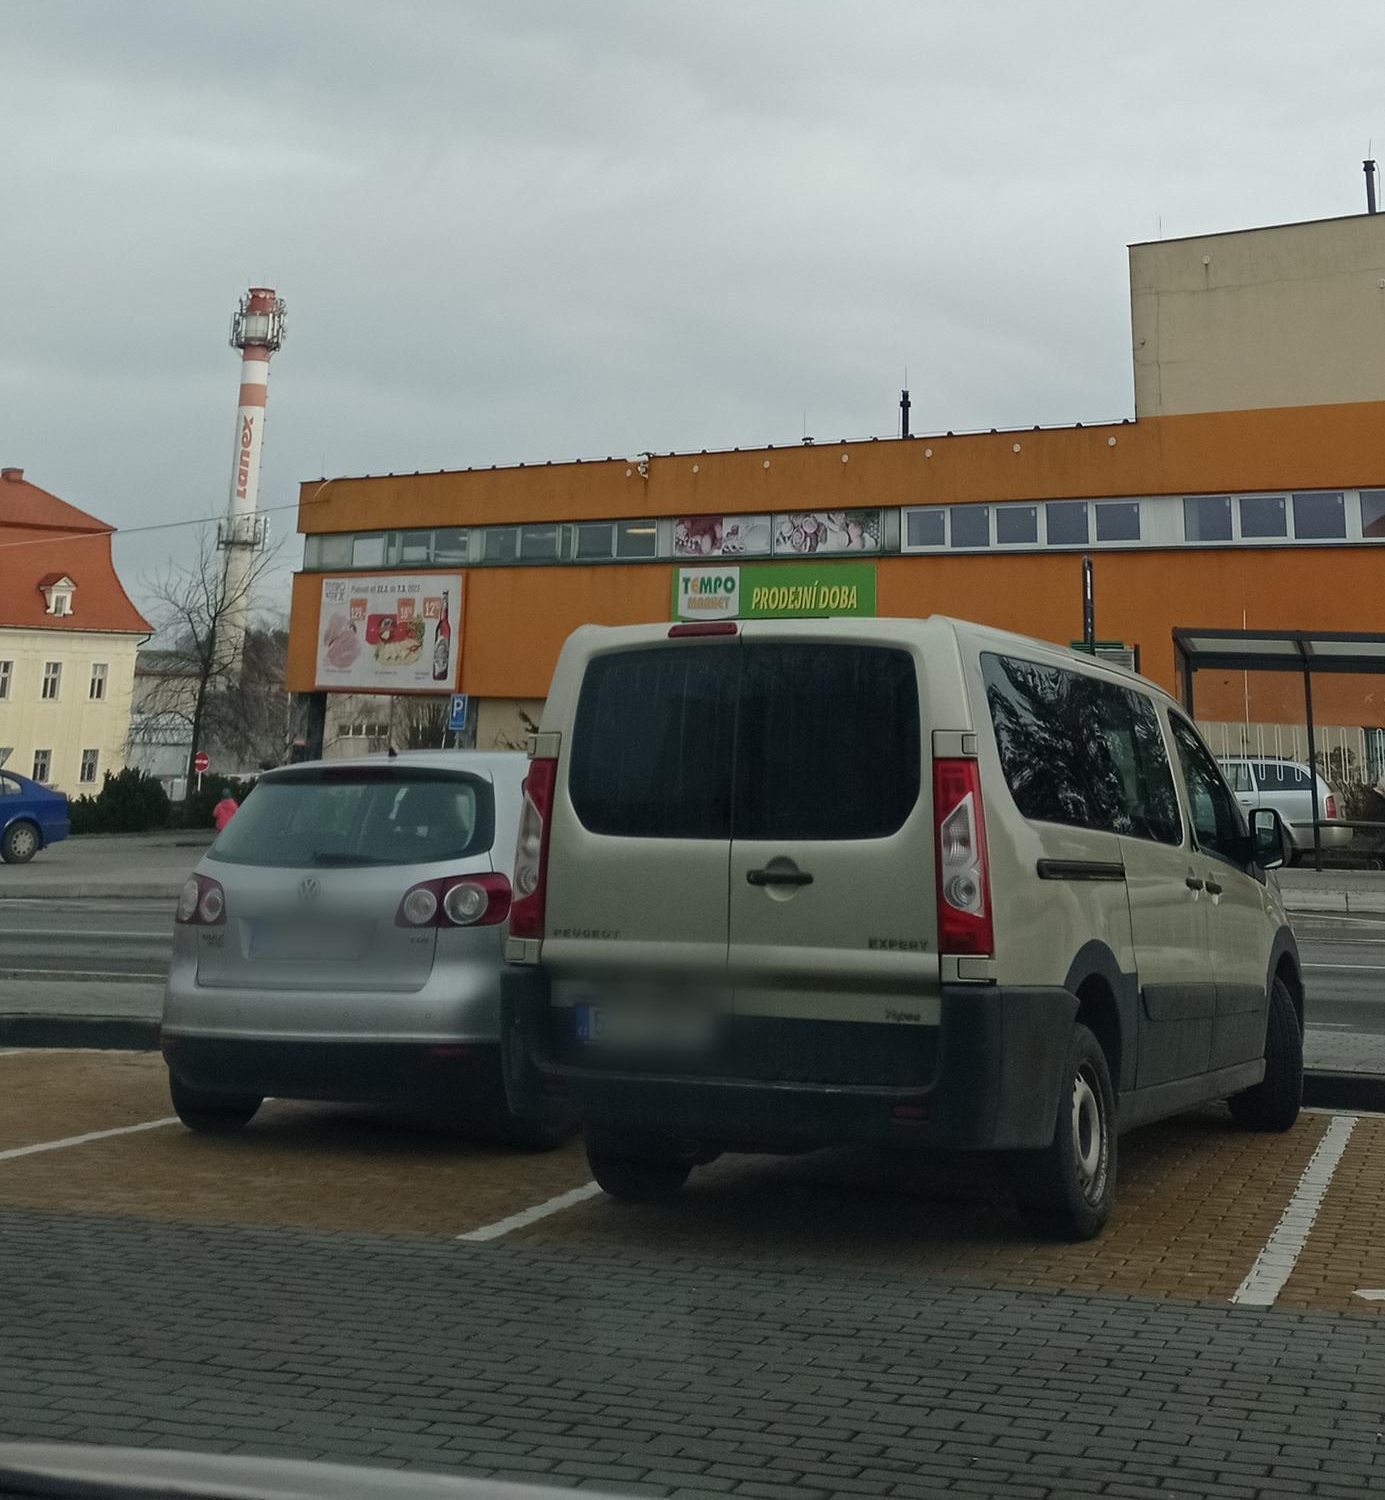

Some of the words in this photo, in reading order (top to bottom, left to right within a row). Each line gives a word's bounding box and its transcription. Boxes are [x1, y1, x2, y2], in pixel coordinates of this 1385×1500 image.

[682, 576, 736, 595] TEMPO
[751, 580, 819, 610] PRODEJNÍ
[818, 585, 857, 609] DOBA
[452, 699, 464, 719] P
[553, 928, 619, 939] PEUGEOT
[868, 938, 929, 951] EXPERT
